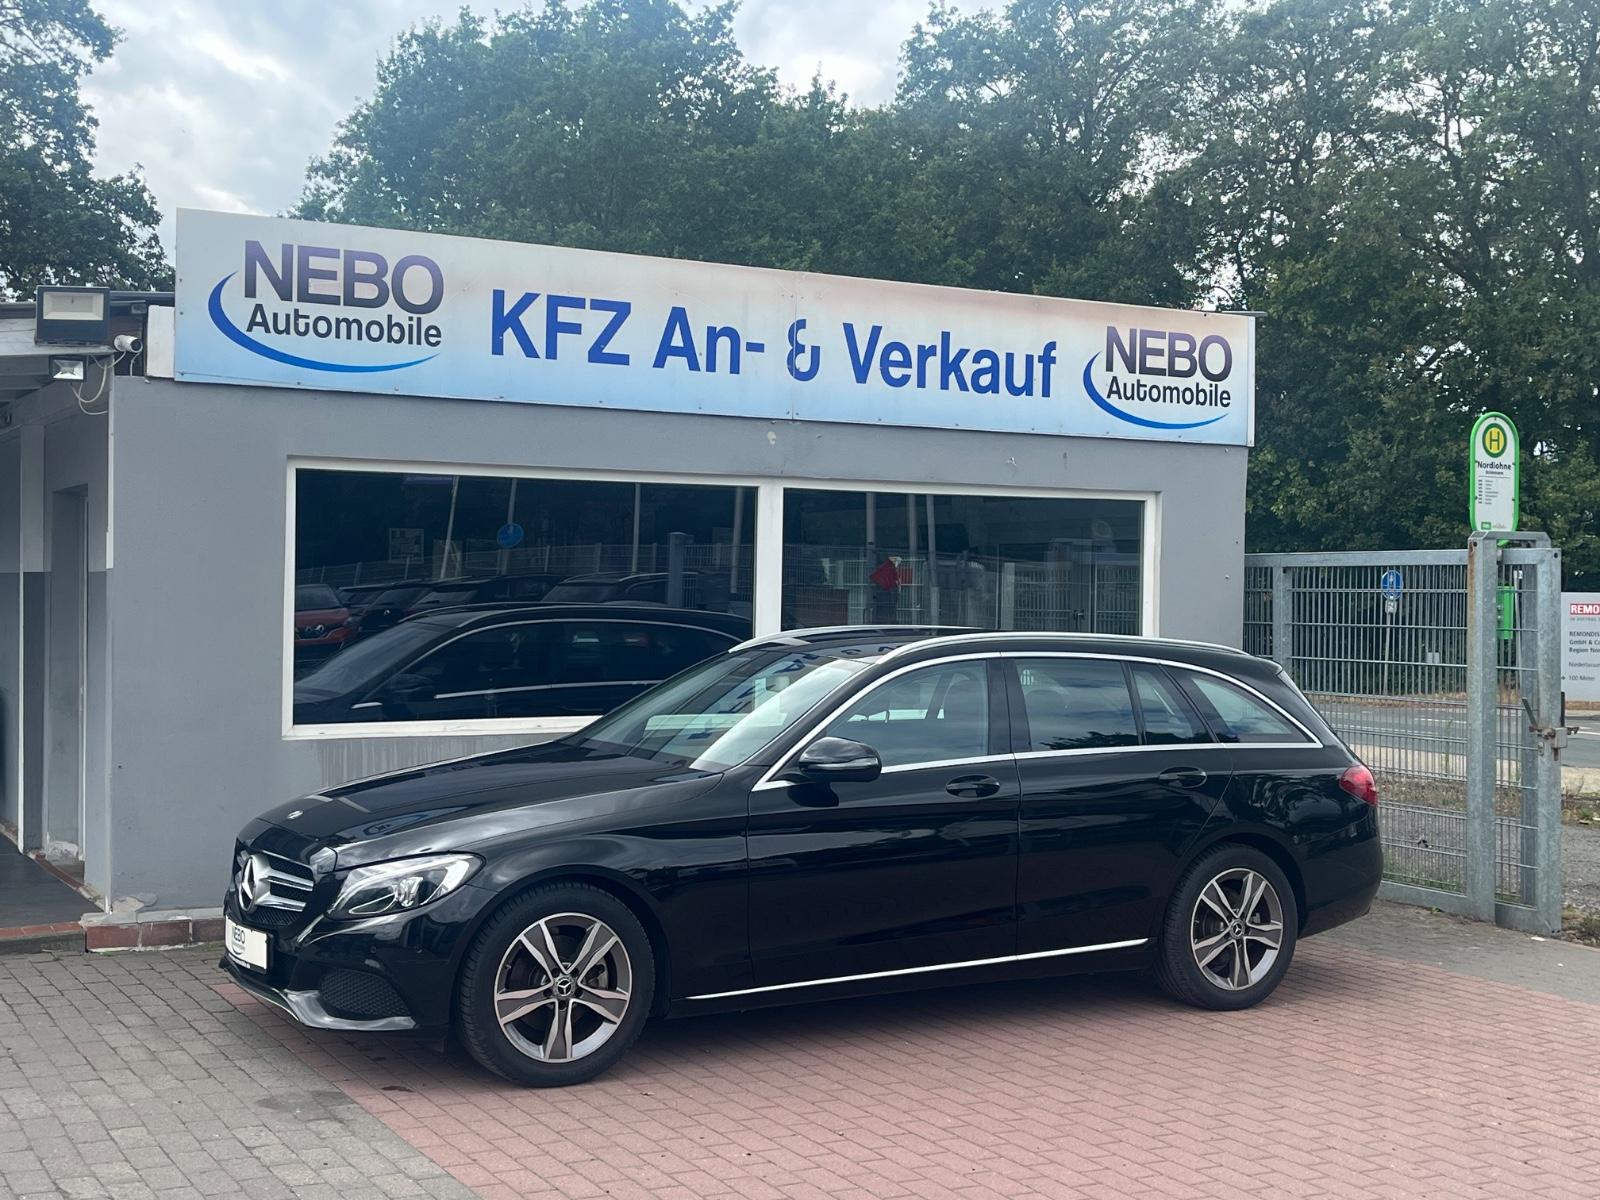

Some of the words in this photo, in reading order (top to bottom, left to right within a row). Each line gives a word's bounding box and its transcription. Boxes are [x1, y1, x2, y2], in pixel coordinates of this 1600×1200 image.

[244, 240, 444, 314] NEBO
[246, 303, 442, 347] Automobile
[491, 289, 631, 366] KFZ
[652, 306, 765, 375] An-
[787, 319, 820, 381] &
[842, 322, 1057, 398] Verkauf
[1105, 326, 1232, 382] NEBO
[1106, 376, 1231, 408] Automobile
[1489, 430, 1500, 451] H
[1477, 460, 1512, 470] Nordlohne
